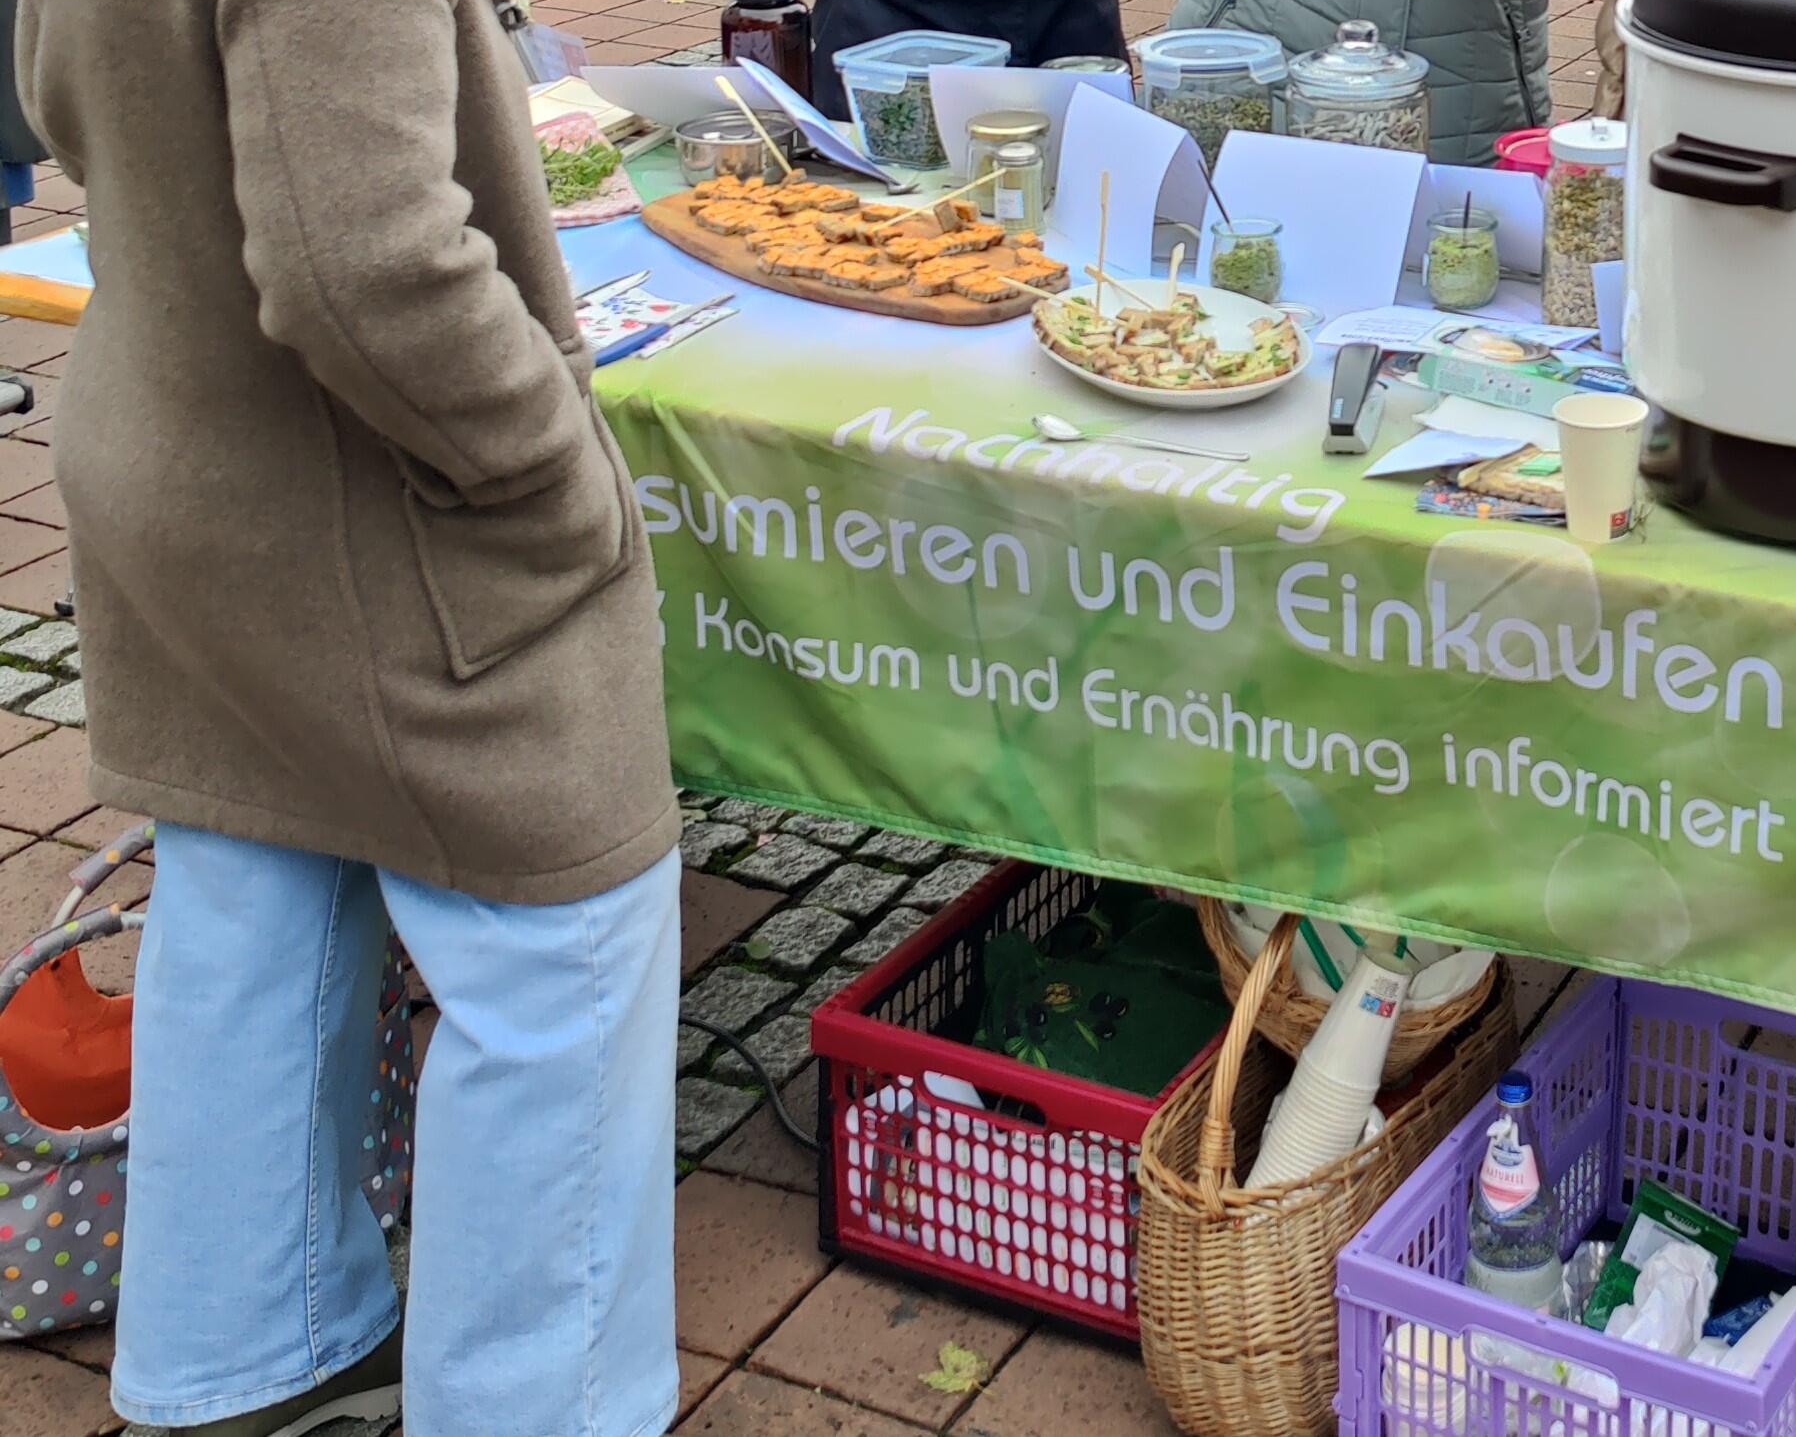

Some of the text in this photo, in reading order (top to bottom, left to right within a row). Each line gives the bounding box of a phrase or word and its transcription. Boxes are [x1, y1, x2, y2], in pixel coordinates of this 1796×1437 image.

[634, 474, 1782, 729] sumieren und Einkaufen
[694, 591, 920, 690] Konsum
[948, 654, 1059, 712] und
[1081, 668, 1409, 794] Ernährung
[1442, 733, 1785, 862] informiert
